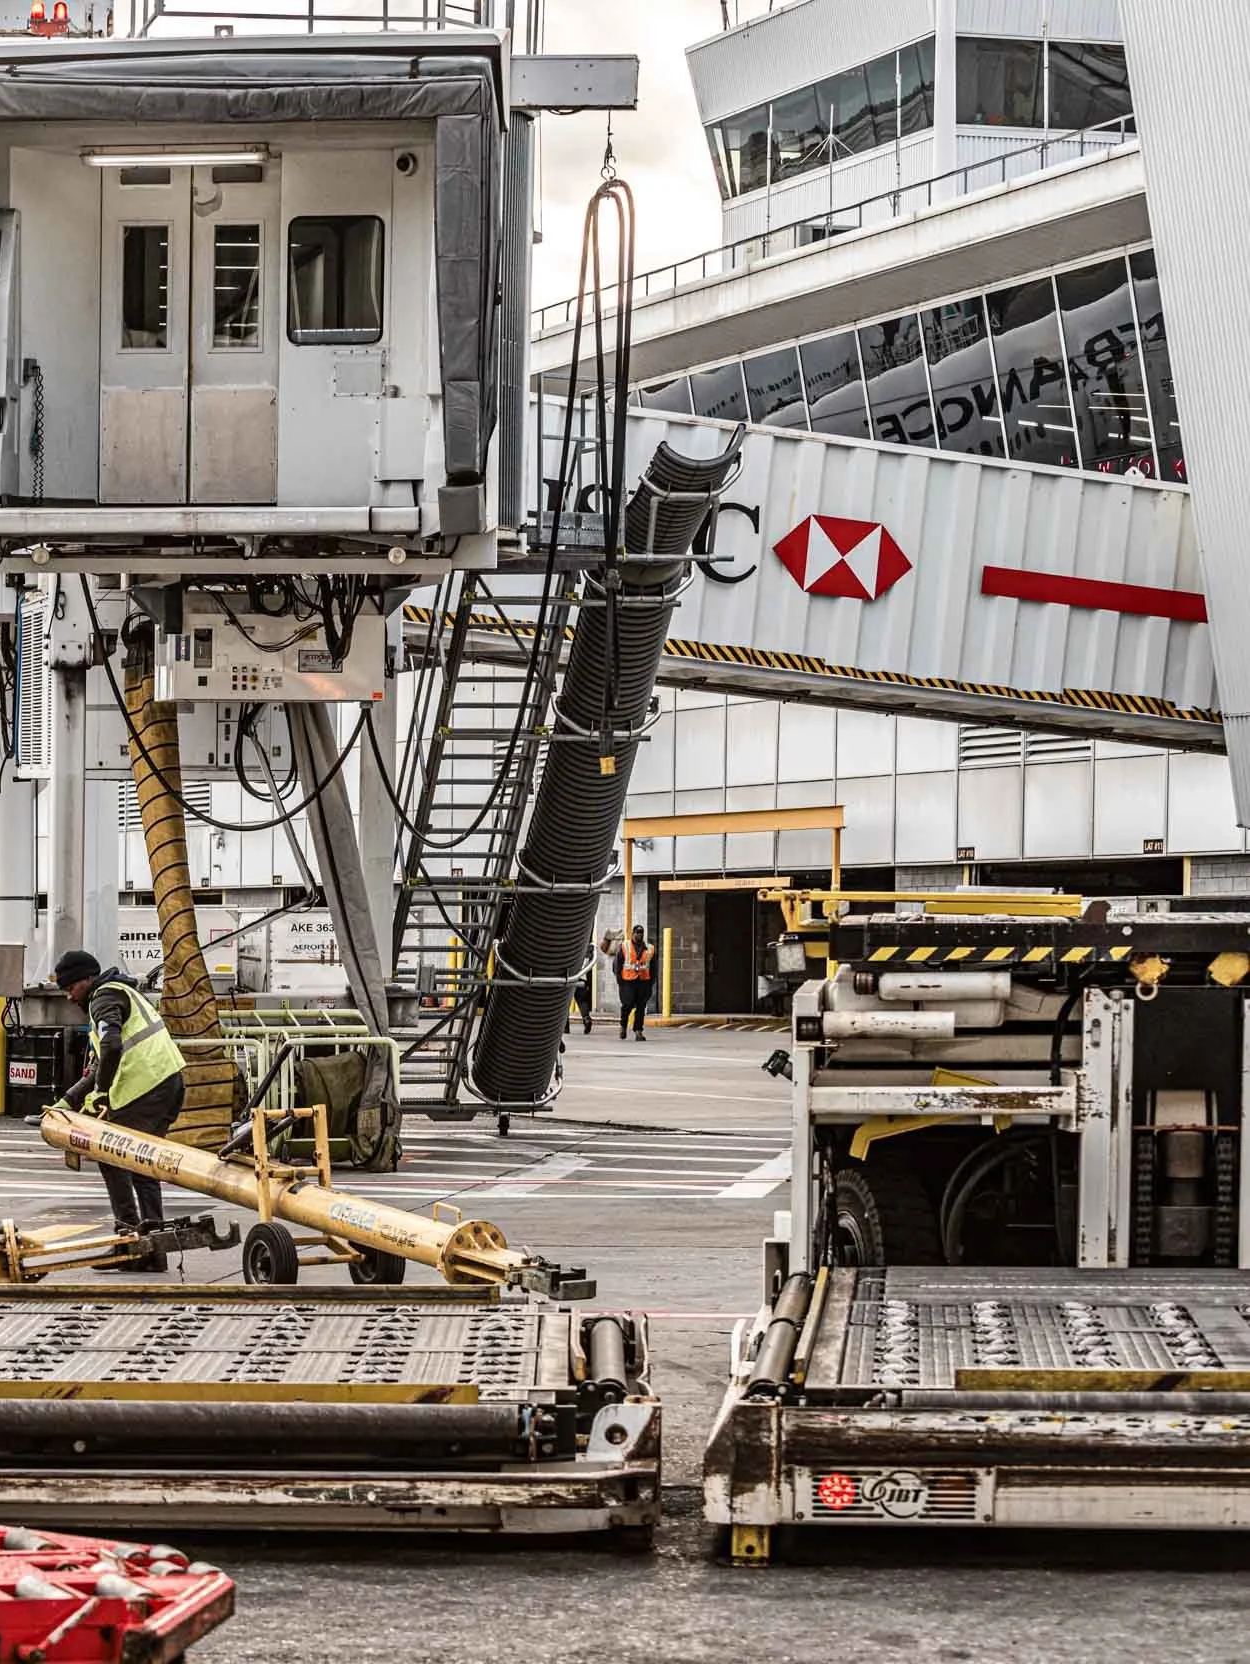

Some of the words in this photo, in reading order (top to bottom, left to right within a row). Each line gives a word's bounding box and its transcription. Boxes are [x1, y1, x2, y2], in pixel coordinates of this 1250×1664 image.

[291, 923, 314, 932] AKE
[316, 923, 335, 932] 363
[10, 1067, 36, 1080] SAND
